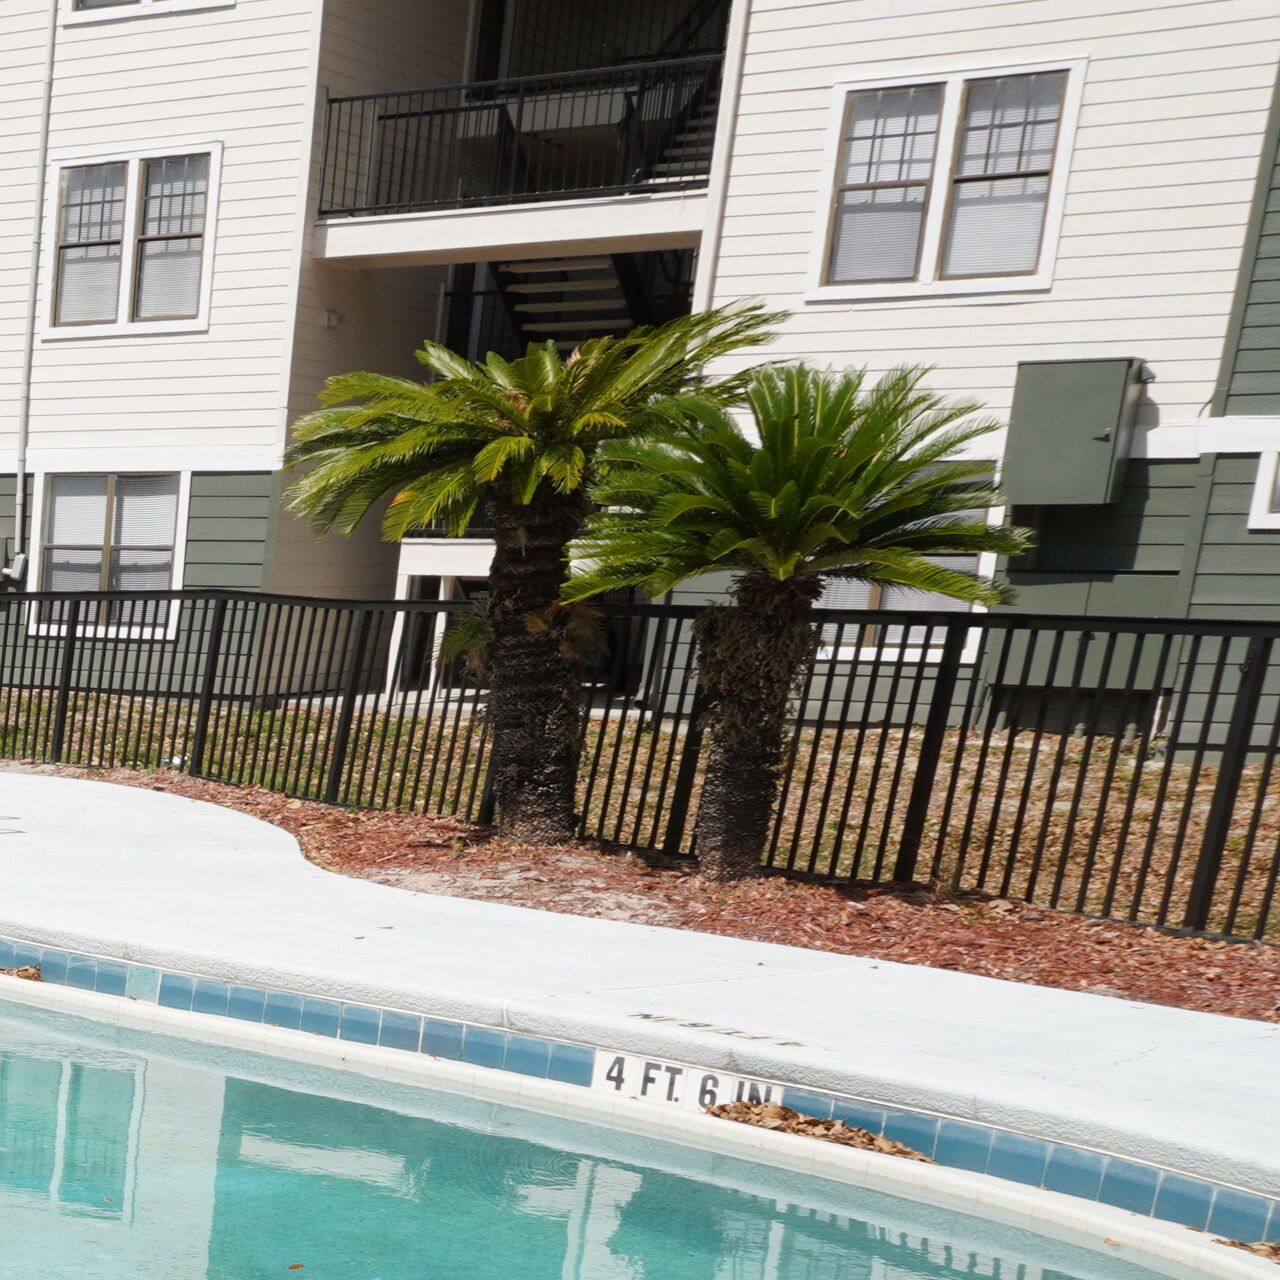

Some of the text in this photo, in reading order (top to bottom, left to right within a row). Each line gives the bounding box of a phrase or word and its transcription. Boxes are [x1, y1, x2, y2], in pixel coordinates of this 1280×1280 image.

[605, 1056, 773, 1109] 4 FT. 6 IN
